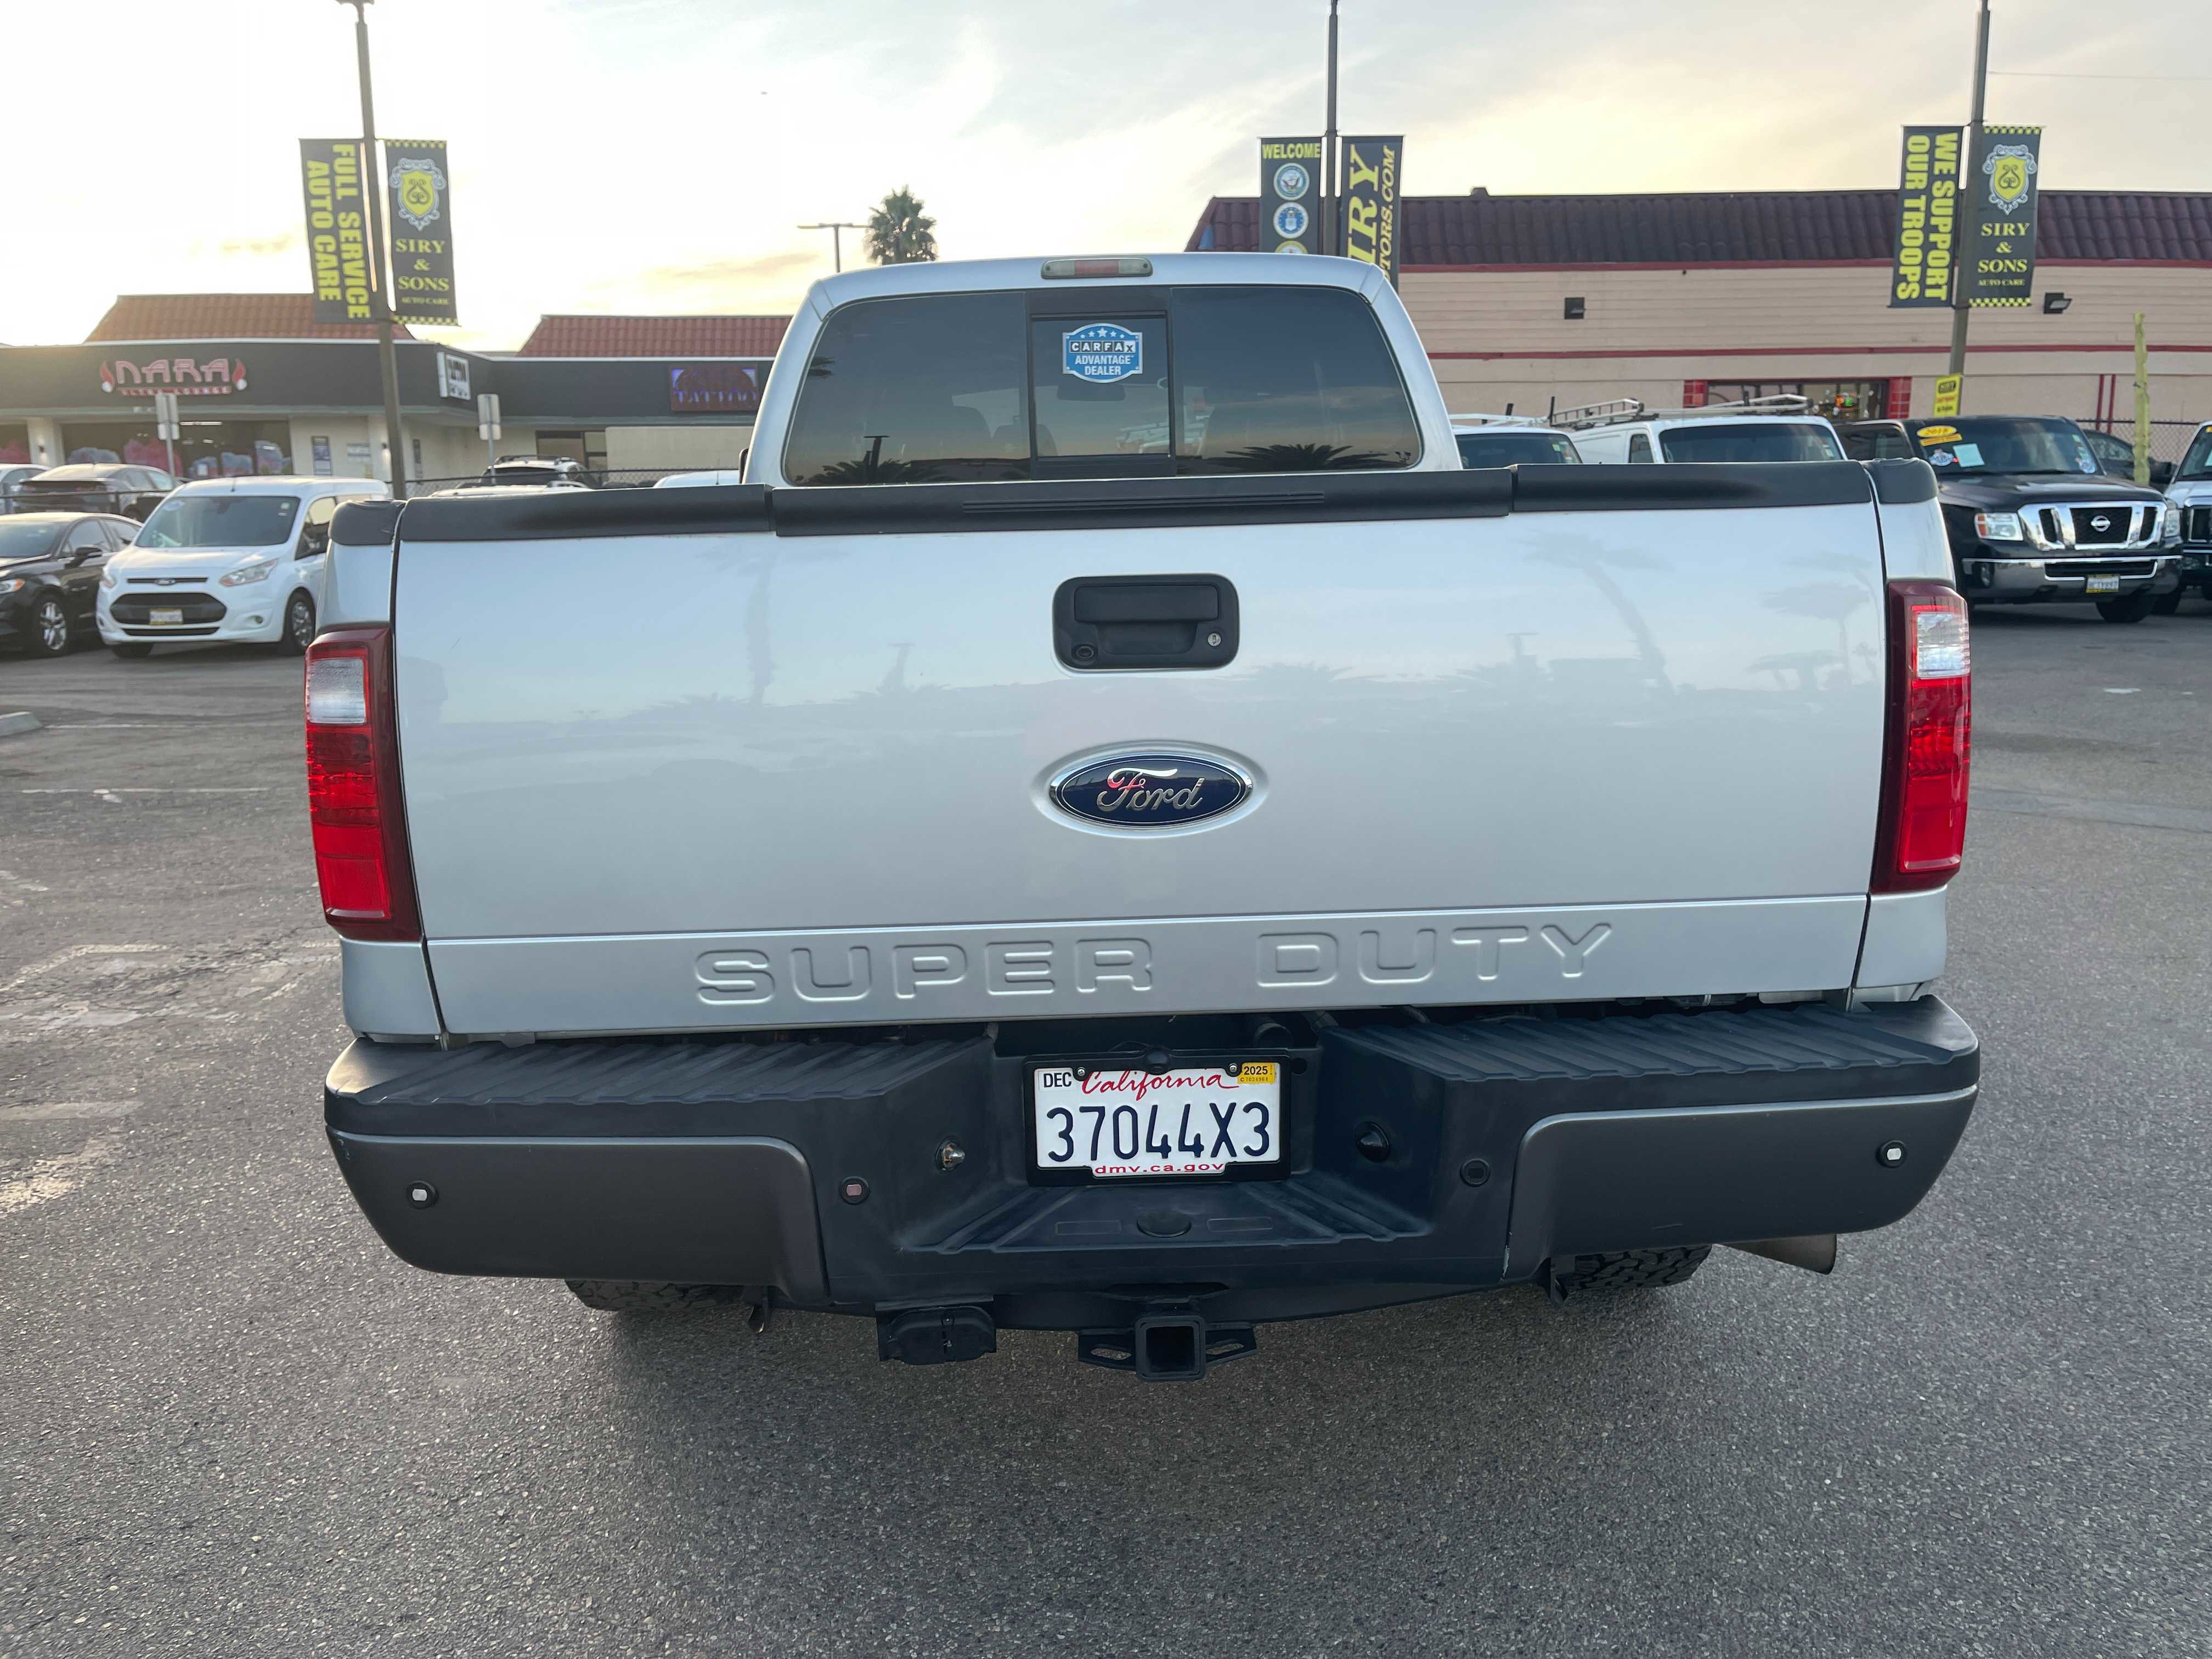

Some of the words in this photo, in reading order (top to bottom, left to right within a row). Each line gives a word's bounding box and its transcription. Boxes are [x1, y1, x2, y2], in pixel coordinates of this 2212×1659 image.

[1262, 143, 1321, 159] WELCOME
[1905, 134, 1931, 190] OUR
[1933, 132, 1958, 175] WE
[332, 144, 358, 200] FULL
[307, 160, 334, 229] AUTO
[1347, 144, 1379, 263] IRY
[1925, 180, 1956, 301] SUPPORT
[1980, 223, 2030, 236] SIRY
[396, 238, 445, 254] SIRY
[1896, 195, 1927, 300] TROOPS
[1996, 241, 2012, 253] &
[313, 235, 342, 301] CARE
[337, 212, 371, 319] SERVICE
[414, 258, 431, 271] &
[1977, 259, 2028, 273] SONS
[398, 276, 449, 291] SONS
[1070, 341, 1135, 353] CARFAX
[115, 359, 230, 383] NARA
[1075, 355, 1131, 364] ADVANTAGE
[1085, 366, 1121, 375] DEALER
[1097, 768, 1205, 812] Ford
[695, 937, 1153, 1006] SUPER
[1256, 922, 1612, 988] DUTY
[1043, 1071, 1073, 1088] DEC
[1244, 1065, 1268, 1075] 2025
[1081, 1070, 1239, 1101] California
[1046, 1102, 1270, 1163] 37044X3
[1094, 1163, 1224, 1175] dmv.ca.gov
